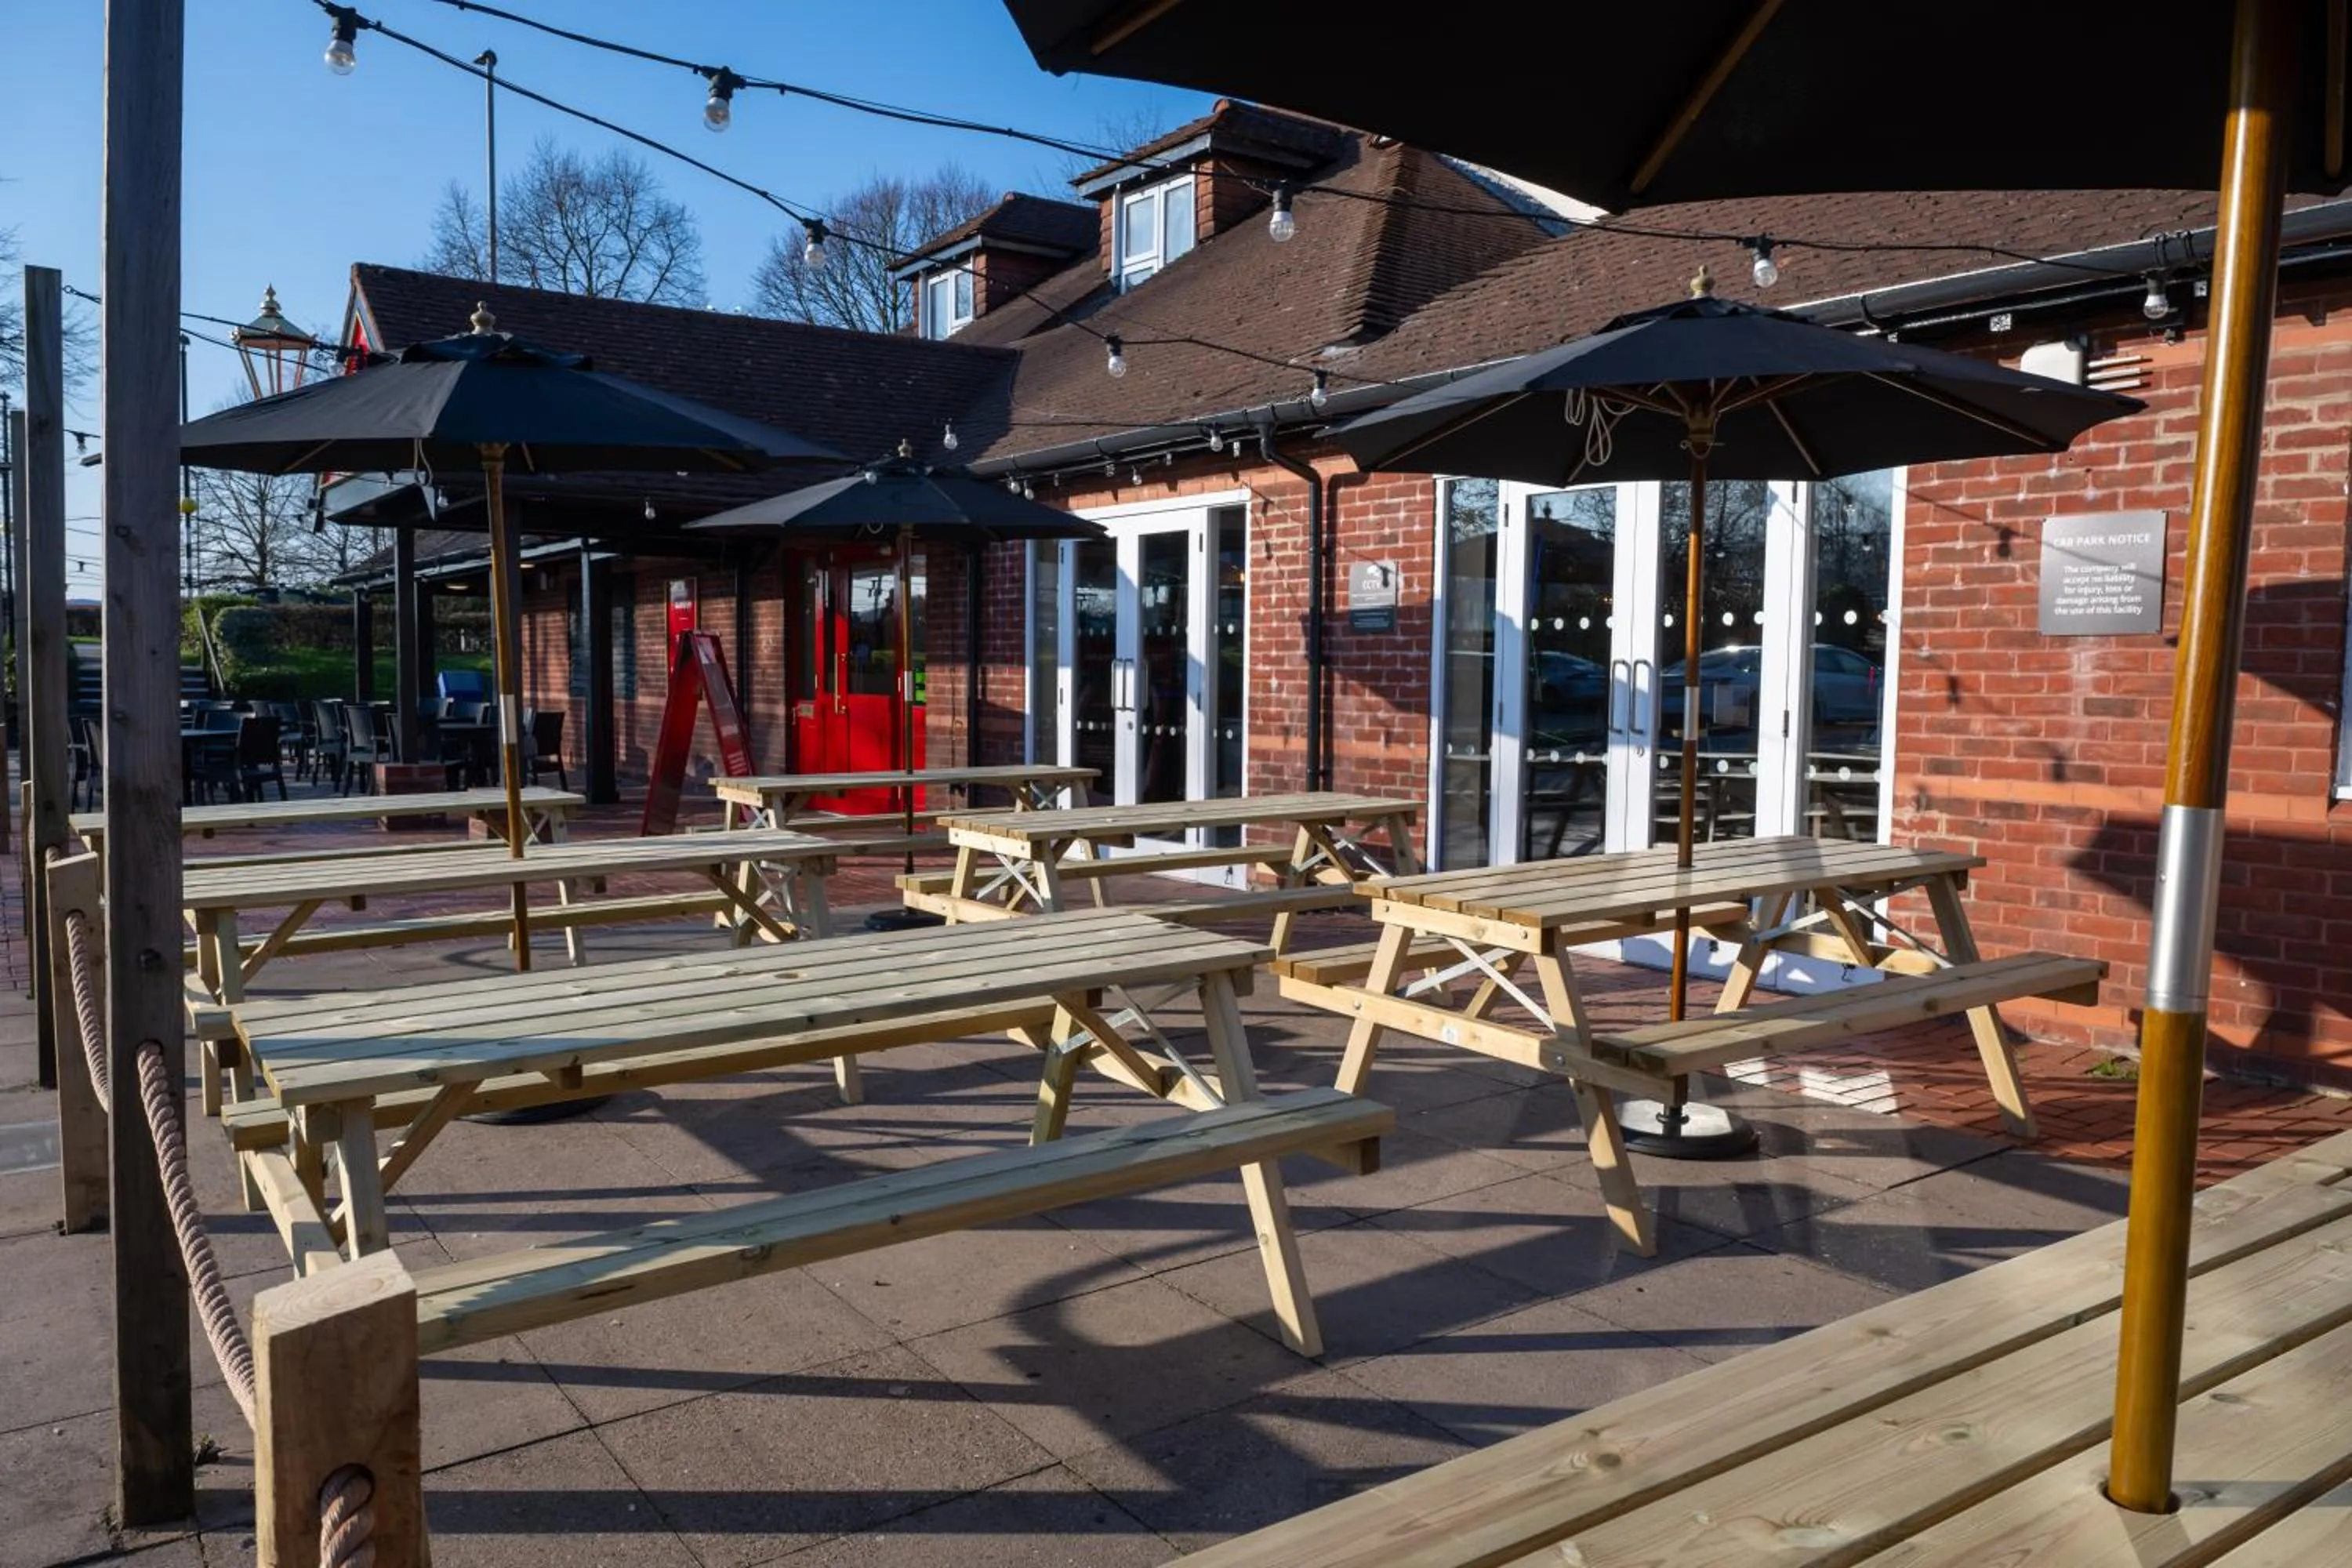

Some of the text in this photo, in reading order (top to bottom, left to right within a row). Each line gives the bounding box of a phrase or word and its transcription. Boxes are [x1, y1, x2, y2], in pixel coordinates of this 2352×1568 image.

[2053, 533, 2150, 547] CAR PARK NOTICE
[2080, 564, 2118, 574] company
[2121, 562, 2136, 571] will
[2103, 573, 2136, 583] liability
[1363, 580, 1382, 590] CCTV
[2077, 586, 2103, 596] injury,
[2105, 584, 2122, 593] loss
[2055, 594, 2142, 606] damage arising from
[2054, 606, 2068, 615] the
[2085, 605, 2095, 614] of
[2096, 604, 2112, 614] this
[2114, 604, 2143, 615] facility
